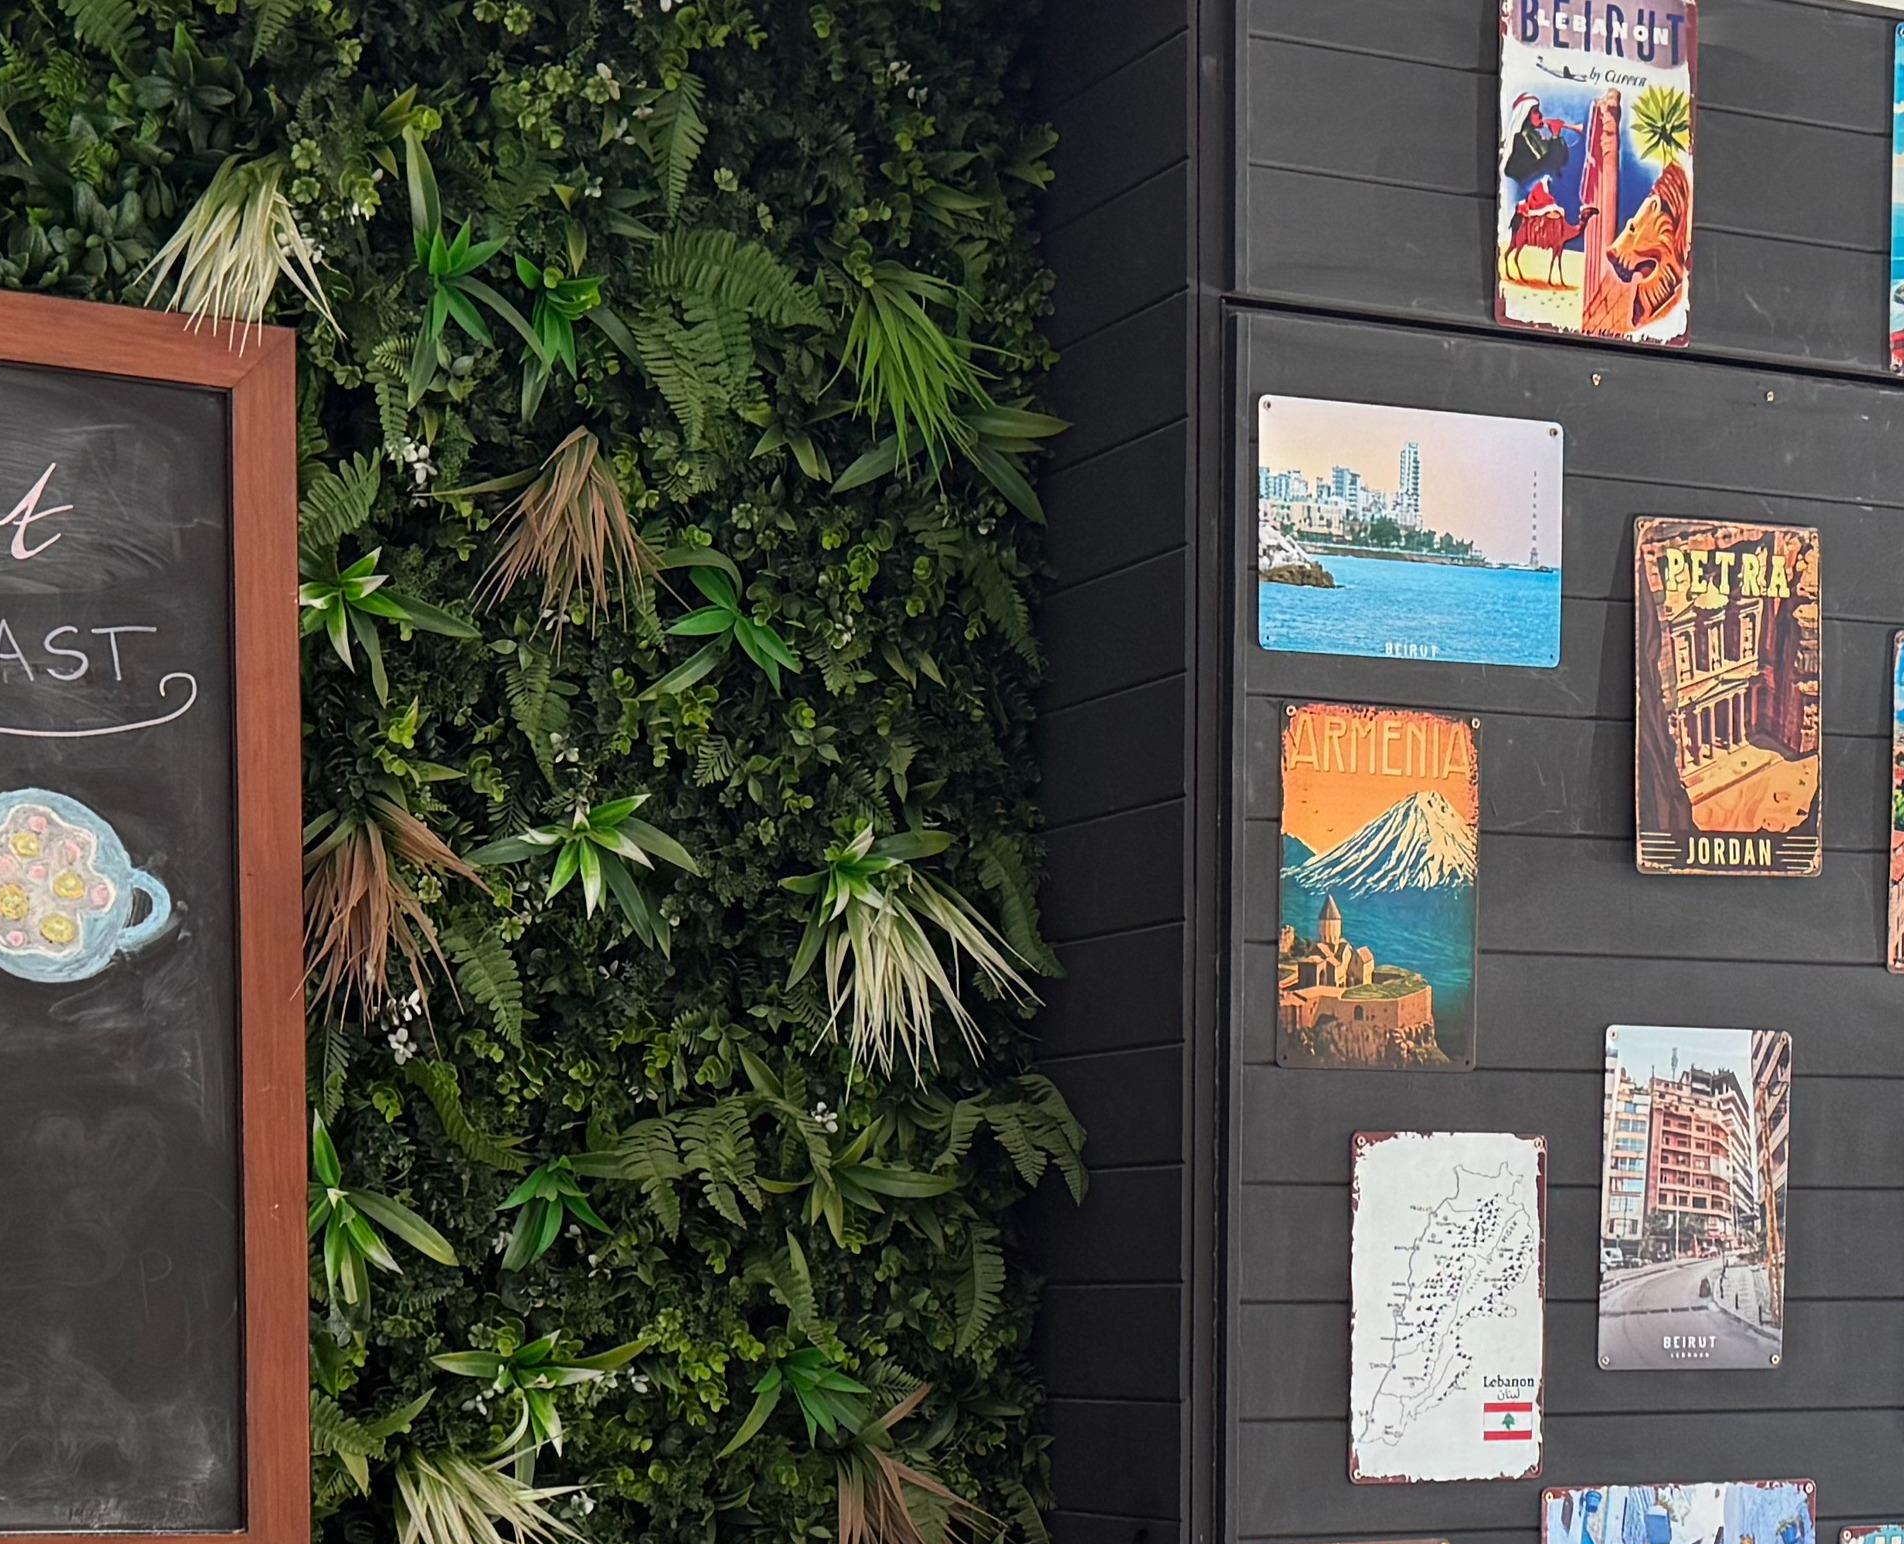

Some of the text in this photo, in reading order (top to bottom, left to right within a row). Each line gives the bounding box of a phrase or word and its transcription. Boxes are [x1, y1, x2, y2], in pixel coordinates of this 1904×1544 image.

[1521, 0, 1684, 65] BEIRUT
[1538, 8, 1670, 46] LEBANON
[1666, 548, 1790, 598] PETRA
[1384, 642, 1441, 657] BEIRUT
[1289, 714, 1470, 779] ARMENIA
[1687, 837, 1771, 865] JORDAN
[1663, 1336, 1716, 1350] BEIRUT
[1484, 1376, 1535, 1388] Lebanon
